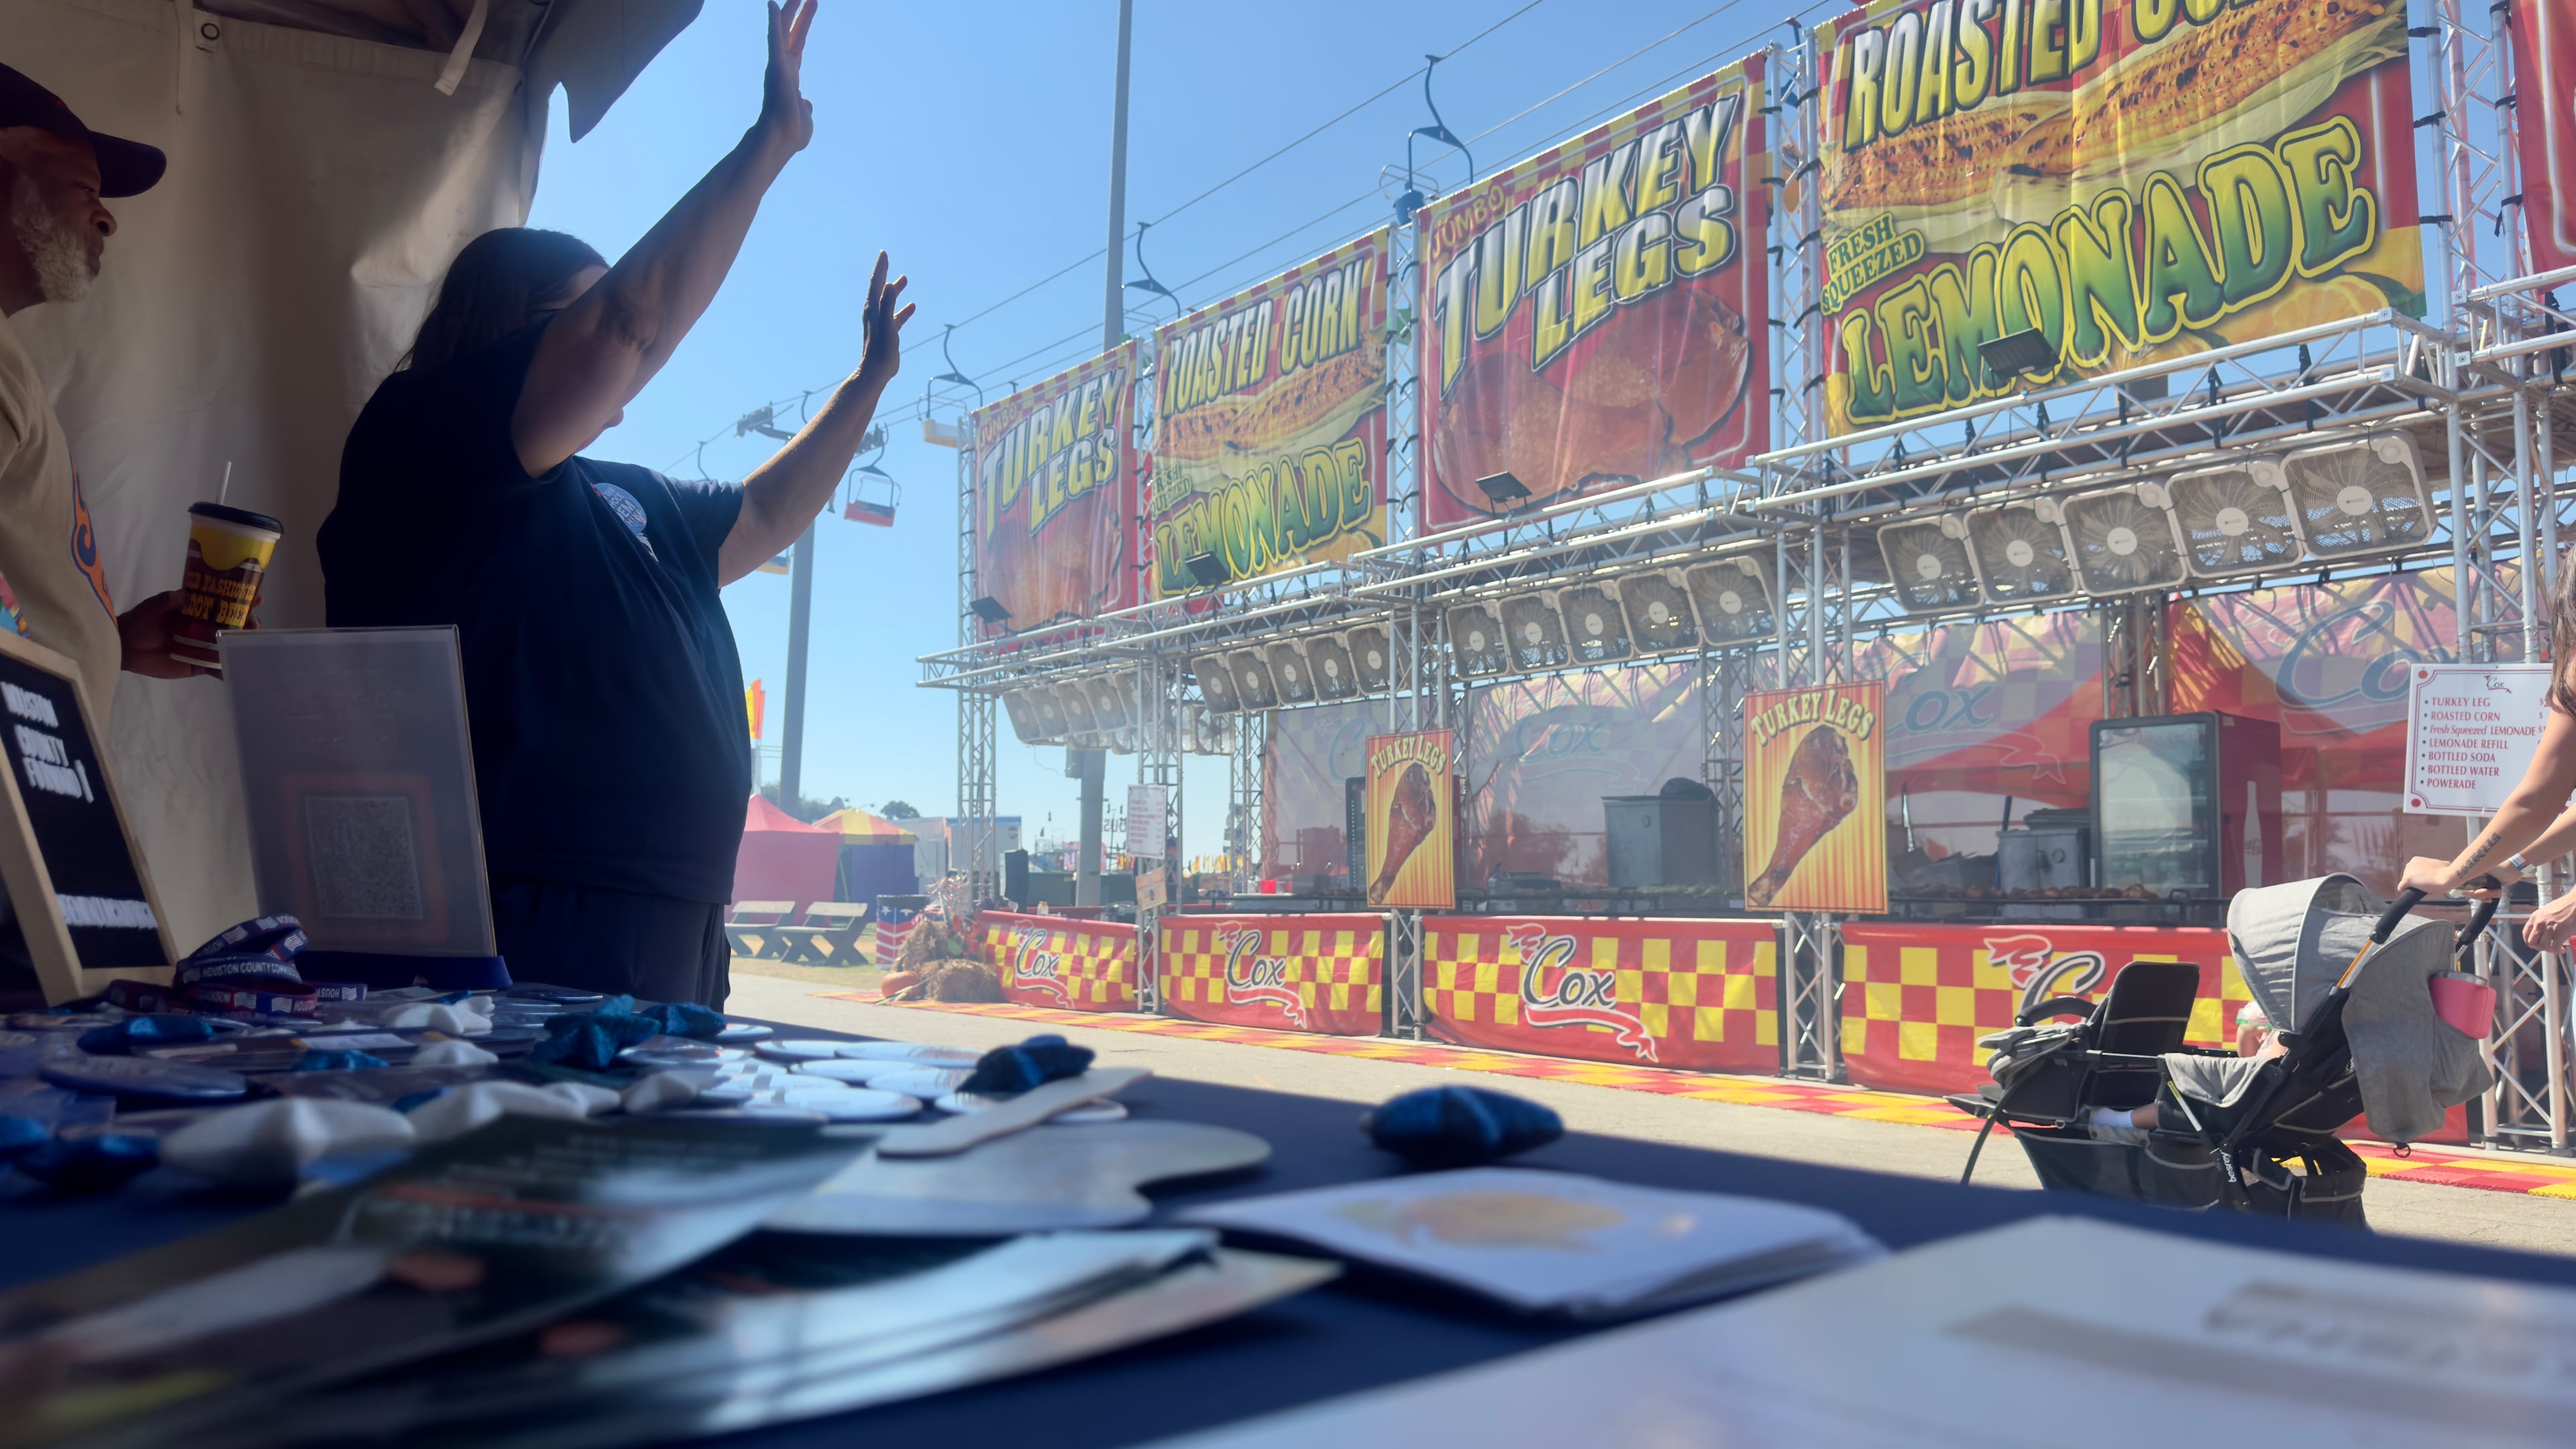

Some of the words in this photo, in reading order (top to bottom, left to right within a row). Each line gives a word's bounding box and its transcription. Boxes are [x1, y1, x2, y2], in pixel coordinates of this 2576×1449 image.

[1843, 0, 2102, 152] ROASTED
[1431, 184, 1505, 259] JUMBO
[1434, 94, 1740, 401] TURKEY
[1828, 215, 1894, 275] FRESH
[1531, 184, 1736, 372] LEGS
[1822, 233, 1922, 313] SQUEEZED
[1841, 115, 2377, 425] LEMONADE
[1161, 299, 1275, 421] ROASTED
[1279, 256, 1364, 376] CORN
[979, 403, 1018, 447] JUMBO
[981, 366, 1126, 546] TURKEY
[1029, 425, 1117, 537] LEGS
[1155, 435, 1373, 596] LEMONADE
[2431, 697, 2469, 707] TURKEY
[2472, 698, 2491, 707] LEG
[2486, 676, 2505, 689] Cox
[1750, 692, 1823, 747] TURKEY
[1824, 688, 1876, 741] LEGS
[2429, 739, 2479, 749] LEMONADE
[2481, 739, 2509, 749] REFILL
[2430, 724, 2450, 735] Fresh
[2451, 724, 2487, 737] Squeezed
[2491, 726, 2536, 736] LEMONADE
[2431, 711, 2471, 721] ROASTED
[2474, 712, 2500, 721] CORN
[1371, 737, 1415, 779] TURKEY
[1417, 735, 1447, 775] LEGS
[2426, 778, 2477, 789] POWERADE
[2428, 751, 2467, 761] BOTTLED
[2470, 752, 2496, 763] SODA
[2428, 765, 2467, 775] BOTTLED
[2469, 765, 2500, 776] WATER
[1016, 928, 1060, 977] Cox
[1226, 929, 1287, 989] Cox
[1522, 934, 1617, 1010] Cox
